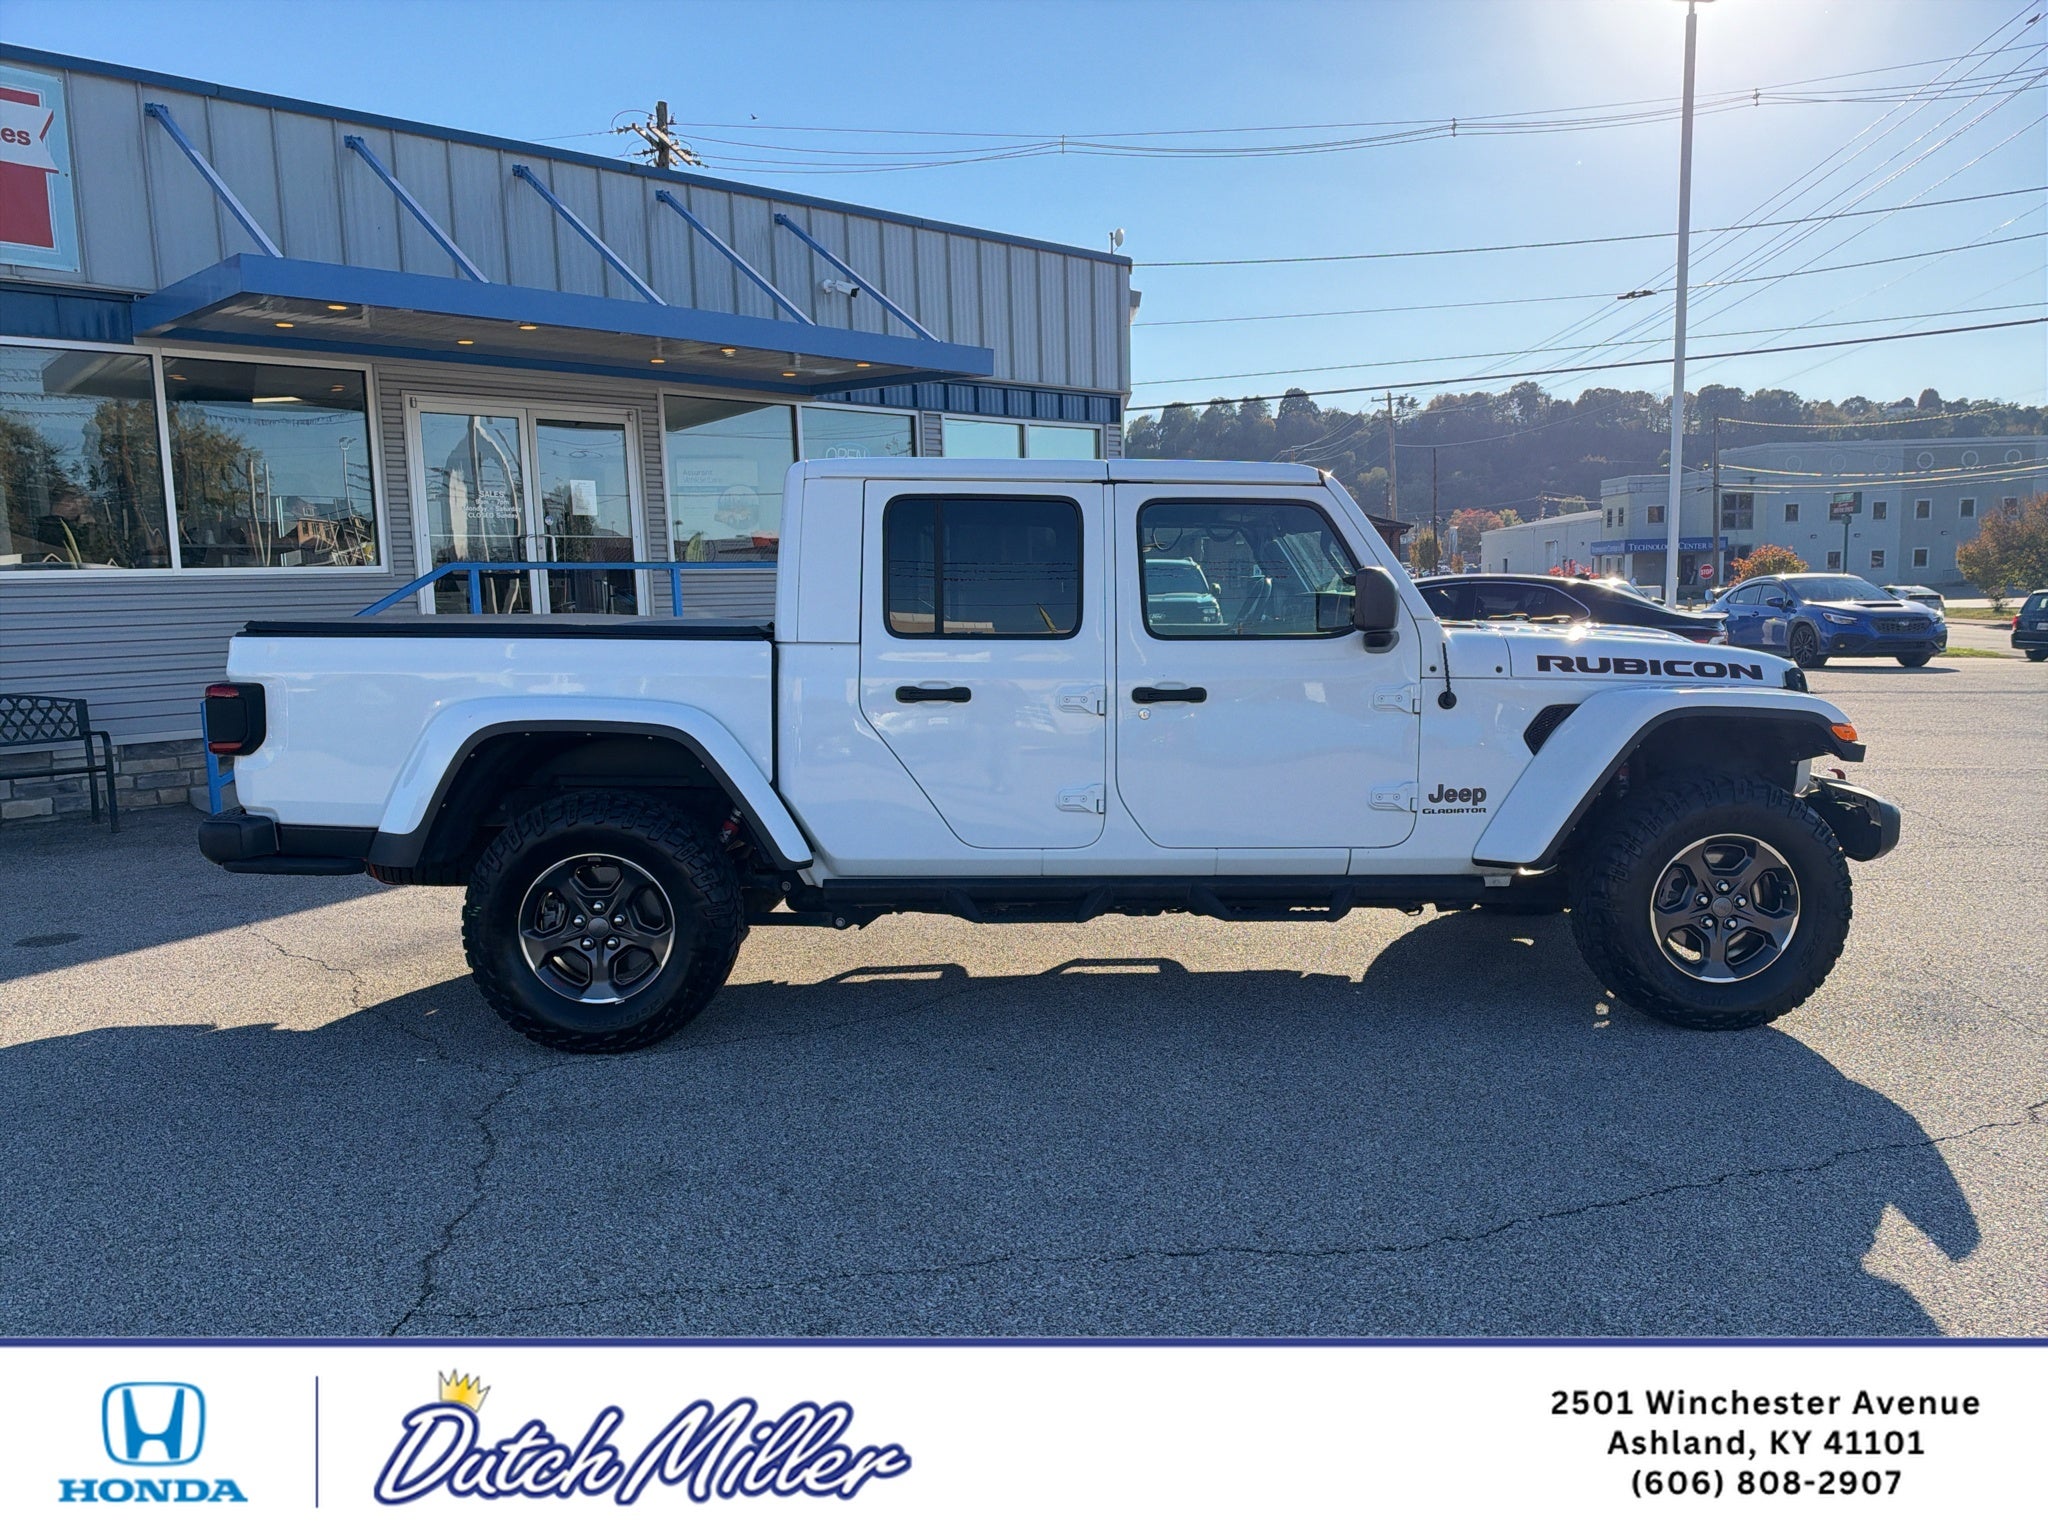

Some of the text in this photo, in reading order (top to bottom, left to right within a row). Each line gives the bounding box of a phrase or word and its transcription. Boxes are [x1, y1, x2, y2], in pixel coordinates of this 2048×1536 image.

[0, 127, 31, 146] es
[826, 447, 866, 459] OPEN
[1628, 543, 1668, 551] TECHNOLO
[1536, 655, 1764, 680] RUBICON
[1428, 784, 1487, 806] Jeep
